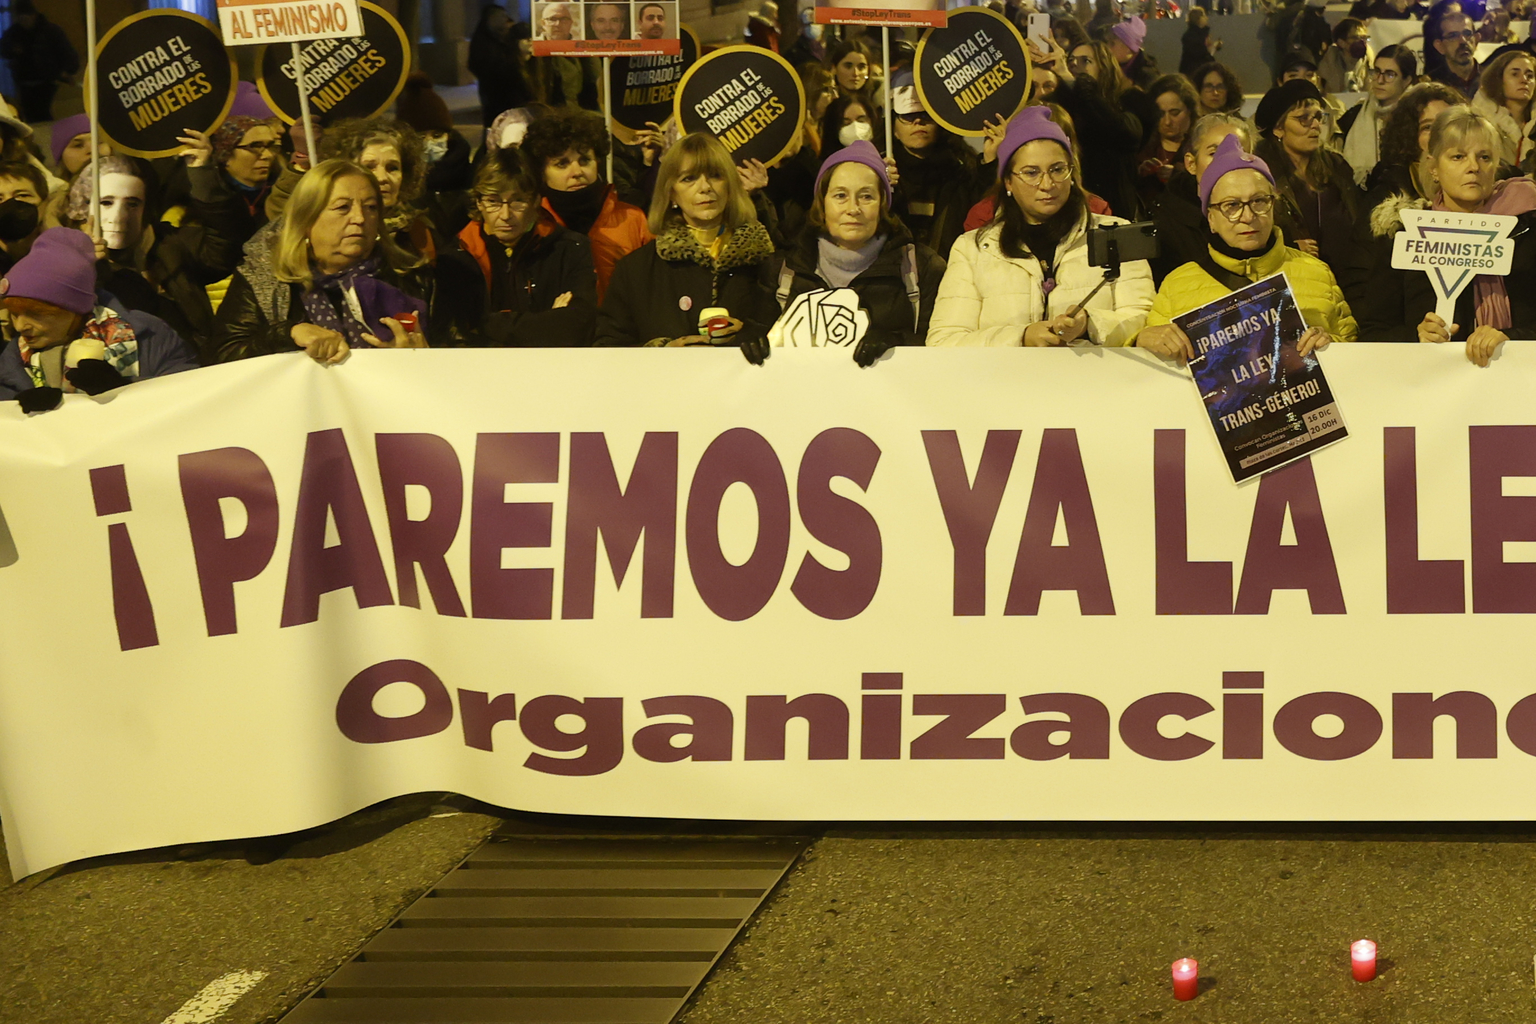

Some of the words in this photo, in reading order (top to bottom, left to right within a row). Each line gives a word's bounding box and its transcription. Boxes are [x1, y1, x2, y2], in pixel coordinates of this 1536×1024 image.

[230, 10, 253, 39] AL
[253, 2, 348, 38] FEMINISMO
[852, 9, 911, 18] #StopLeyTrans
[182, 54, 194, 65] DE
[280, 38, 340, 80] CNTRA
[629, 54, 671, 69] CONTRA
[673, 49, 684, 62] EL
[933, 39, 977, 79] CONTRA
[975, 29, 993, 48] EL
[988, 45, 997, 54] DE
[992, 50, 1003, 62] LAS
[108, 46, 171, 89] CONTRA
[166, 36, 191, 57] EL
[187, 60, 202, 73] LAS
[943, 52, 993, 95] BORRADO
[118, 61, 187, 109] BORRADO
[310, 48, 387, 114] MUJERES
[626, 66, 674, 86] BORRADO
[756, 82, 766, 92] DE
[953, 60, 1015, 114] MUJERES
[128, 72, 212, 131] MUJERES
[623, 82, 679, 106] MUJERES
[694, 78, 746, 119] CONTRA
[740, 68, 761, 86] EL
[761, 87, 773, 98] LAS
[706, 89, 762, 134] BORRADO
[718, 96, 785, 153] MUJERES
[1417, 217, 1501, 227] PARTIDO
[1405, 240, 1504, 258] FEMINISTAS
[1412, 255, 1425, 264] AL
[1429, 256, 1494, 268] CONGRESO
[1251, 288, 1276, 300] FEMINISTA
[1196, 316, 1261, 354] ¡PAREMOS
[1260, 308, 1281, 326] YA
[1231, 365, 1251, 383] LA
[1251, 353, 1273, 377] LEY
[1219, 378, 1321, 432] TRANS-GÉNERO!
[1308, 414, 1318, 423] 16
[1318, 408, 1331, 419] Dic
[1310, 418, 1338, 435] 20.00H
[1234, 437, 1261, 451] Convocan
[1256, 434, 1286, 448] Feministas
[922, 428, 1116, 616] YA
[1154, 428, 1347, 616] LA
